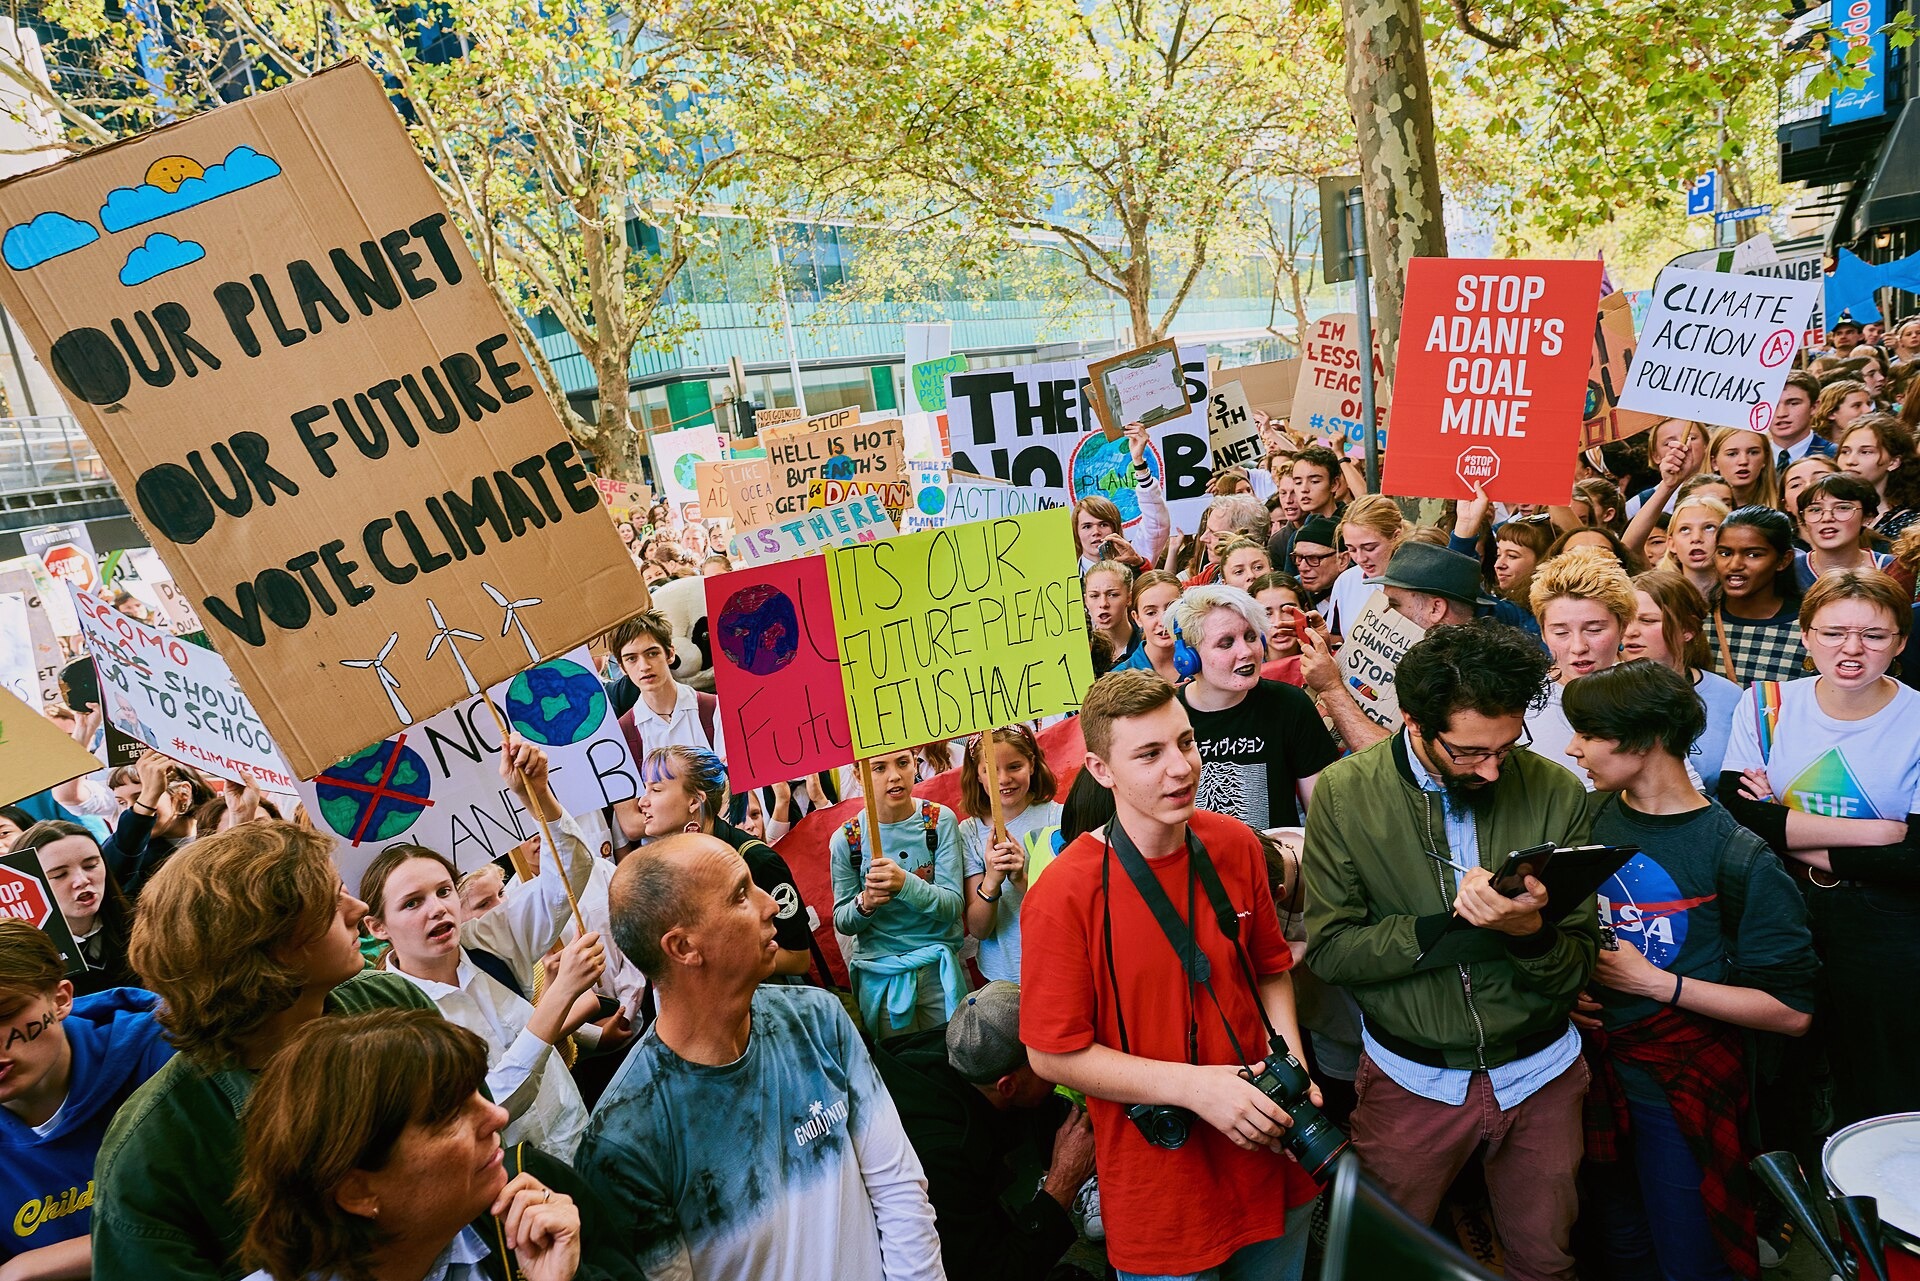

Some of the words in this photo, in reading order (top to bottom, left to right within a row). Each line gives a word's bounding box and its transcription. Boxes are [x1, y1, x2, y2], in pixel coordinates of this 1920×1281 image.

[50, 302, 221, 405] OUR
[213, 212, 463, 358] PLANET
[1455, 274, 1545, 313] STOP
[1664, 283, 1793, 324] CLIMATE
[1317, 320, 1346, 341] IM
[1424, 315, 1565, 356] ADANI'S
[1652, 319, 1756, 357] ACTION
[917, 358, 957, 377] WHO
[1446, 357, 1533, 396] COAL
[1637, 360, 1765, 406] POLITICIANS
[757, 412, 772, 422] NOT
[772, 410, 792, 420] GOING
[792, 409, 801, 418] TO
[808, 410, 850, 433] STOP
[1440, 397, 1529, 438] MINE
[1754, 407, 1766, 429] F
[135, 431, 299, 544] OUR
[291, 333, 534, 478] FUTURE
[771, 441, 820, 466] HELL
[828, 436, 846, 455] IS
[854, 429, 897, 452] HOT
[1212, 434, 1260, 473] ANET
[730, 463, 762, 485] LIKE
[786, 467, 816, 488] BUT
[820, 453, 887, 480] EARTH'S
[908, 461, 939, 471] THERE
[921, 474, 941, 483] NO
[952, 446, 1063, 489] NO
[1162, 433, 1213, 501] B
[1463, 465, 1491, 477] ADANI
[1464, 455, 1493, 467] #STOP
[737, 506, 759, 527] WE
[775, 494, 807, 515] GET
[908, 516, 945, 527] PLANET
[950, 487, 1037, 521] ACTION
[203, 539, 374, 648] VOTE
[363, 441, 600, 585] CLIMATE
[744, 528, 780, 558] IS
[780, 495, 887, 546] THERE
[834, 542, 903, 620] IT'S
[928, 519, 1026, 601] OUR
[76, 592, 188, 666] SCOMO
[842, 601, 972, 689] FUTURE
[981, 576, 1083, 651] PLEASE
[1363, 609, 1411, 651] POLITICAL
[97, 654, 129, 692] GO
[138, 681, 177, 718] TO
[1348, 648, 1394, 687] STOP
[850, 678, 911, 750] LET
[930, 669, 963, 738] US
[964, 661, 1044, 730] HAVE
[1057, 654, 1083, 706] 1
[118, 743, 136, 752] LET'S
[424, 697, 511, 779] NO
[586, 738, 638, 807] B
[1792, 790, 1859, 817] THE
